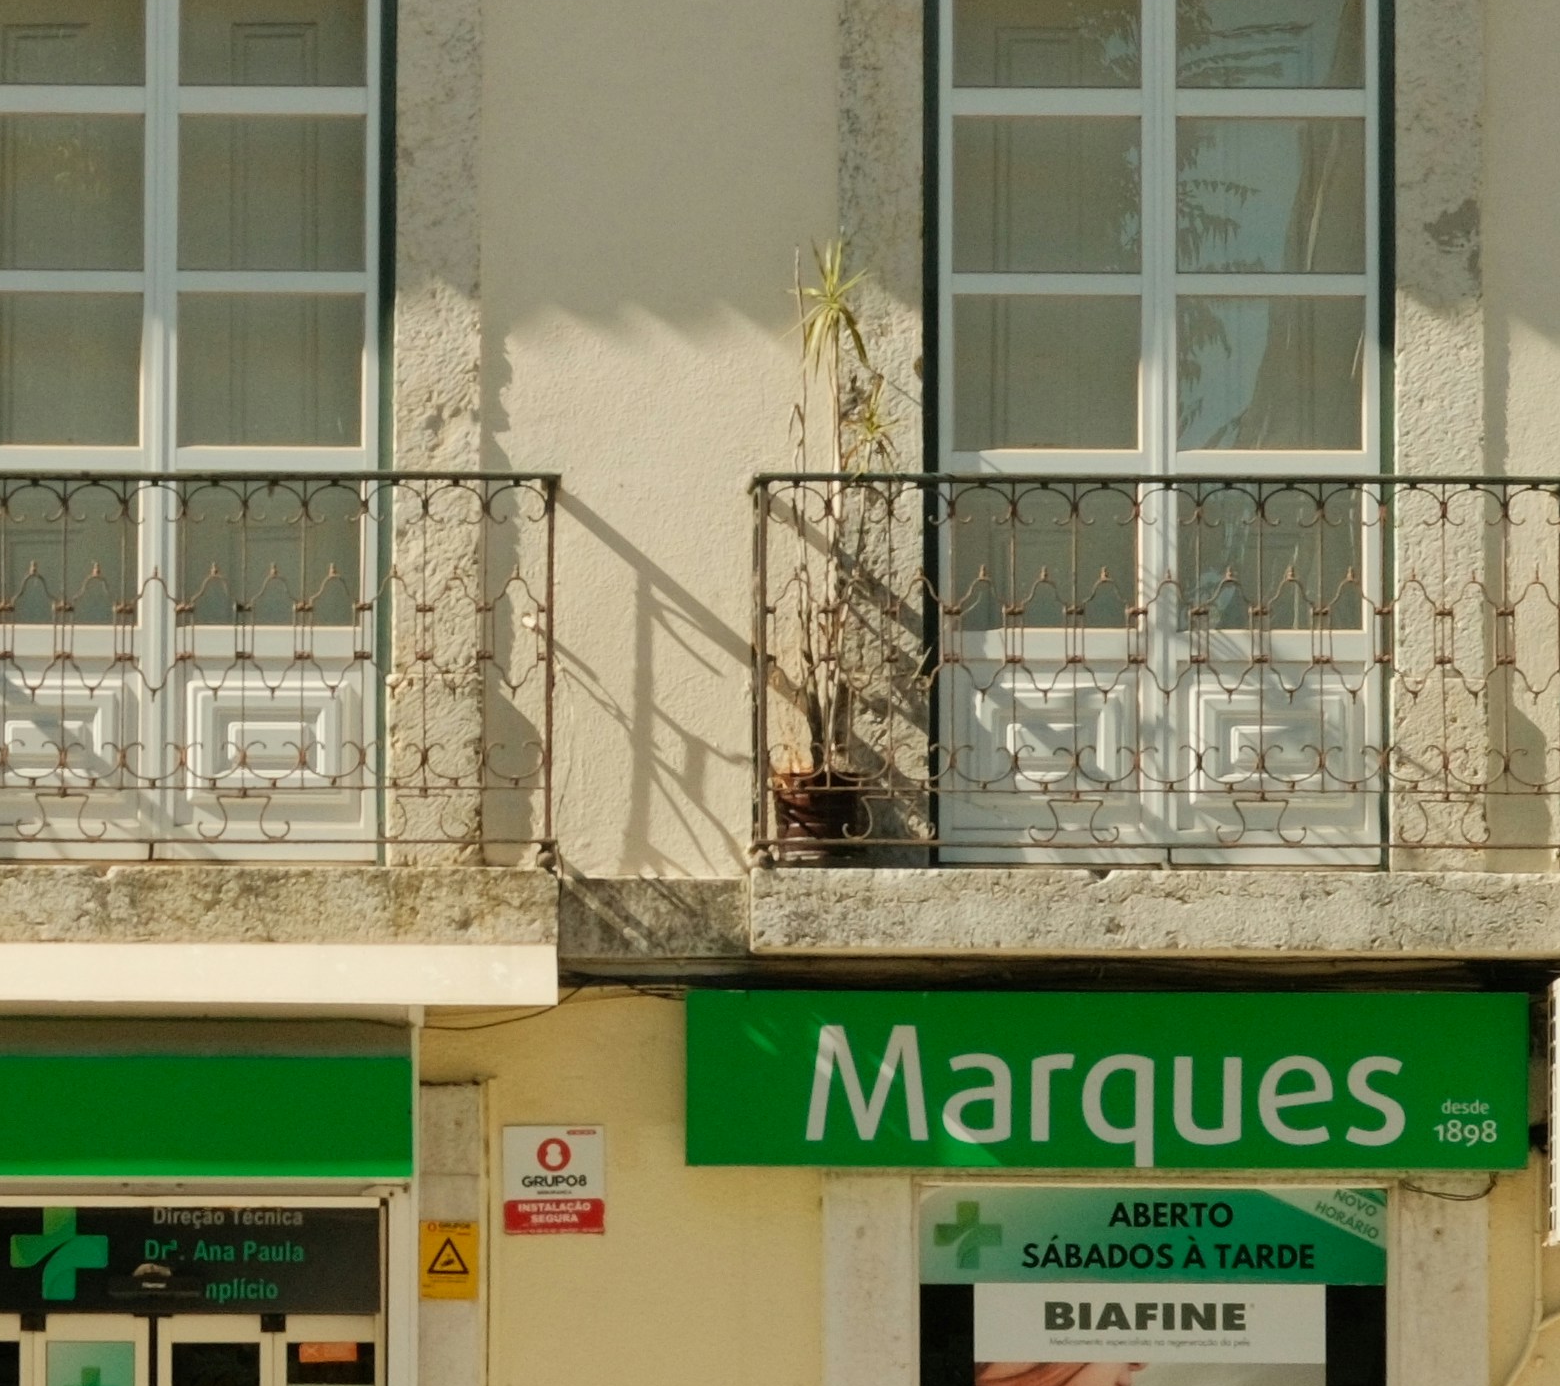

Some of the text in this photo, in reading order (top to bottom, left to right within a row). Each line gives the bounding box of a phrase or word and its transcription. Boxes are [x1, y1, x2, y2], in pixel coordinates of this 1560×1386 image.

[803, 1023, 1408, 1169] Marques
[1441, 1099, 1489, 1117] desde
[1433, 1120, 1499, 1147] 1898
[521, 1175, 587, 1187] GRUPO8
[518, 1202, 591, 1213] INSTALAÇÃO
[1108, 1202, 1234, 1228] ABERTO
[1333, 1189, 1377, 1216] NOVO
[530, 1214, 579, 1224] SEGURA
[1315, 1201, 1378, 1239] HORÁRIO
[194, 1240, 234, 1261] Ana
[244, 1240, 304, 1261] Paula
[1022, 1235, 1315, 1269] SÁBADOS À TARDE
[1045, 1301, 1246, 1331] BIAFINE
